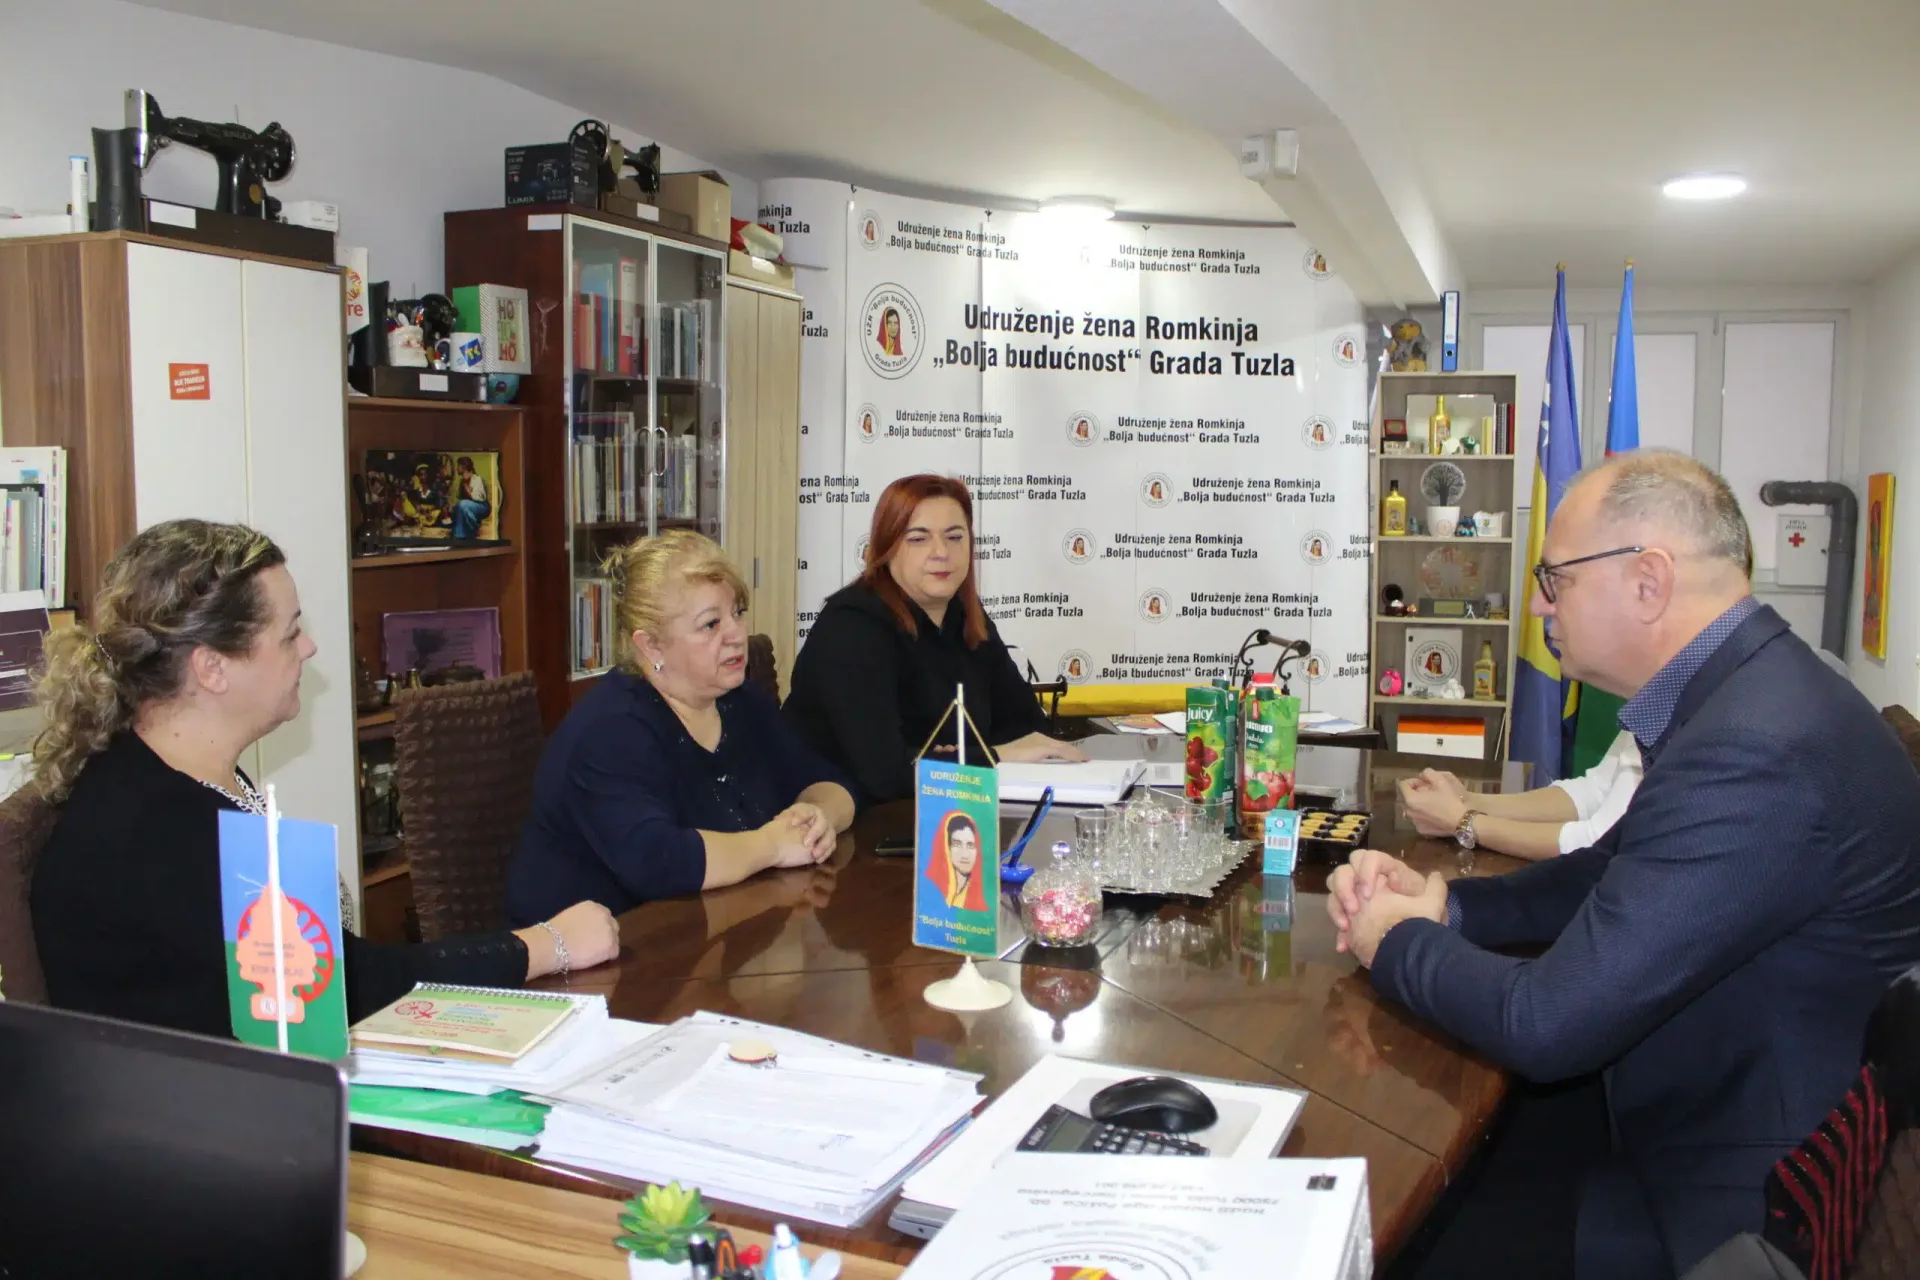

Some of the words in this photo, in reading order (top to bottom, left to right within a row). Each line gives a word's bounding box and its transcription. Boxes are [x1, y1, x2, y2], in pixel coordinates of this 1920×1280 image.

[758, 204, 792, 219] mkinja
[779, 220, 810, 234] Tuzla
[898, 220, 941, 238] Udruženje
[943, 225, 963, 240] žena
[966, 230, 1006, 246] Romkinja
[966, 245, 992, 258] Grada
[994, 247, 1019, 261] Tuzla
[1119, 244, 1168, 260] Udruženje
[1171, 246, 1196, 259] žena
[1198, 248, 1245, 261] Romkinja
[1200, 262, 1231, 274] Grada
[1234, 263, 1260, 275] Tuzla
[801, 324, 829, 338] Tuzla
[964, 303, 1075, 340] Udruženje
[1082, 311, 1136, 339] žena
[1145, 315, 1259, 347] Romkinja
[933, 339, 998, 372] „Bolja
[1005, 343, 1142, 374] budućnost“
[1150, 350, 1222, 376] Grada
[1231, 351, 1295, 377] Tuzla
[896, 409, 937, 423] Udruženje
[939, 411, 960, 423] žena
[1118, 415, 1167, 430] Udruženje
[1170, 417, 1194, 429] žena
[1197, 418, 1245, 431] Romkinja
[993, 427, 1014, 439] Tuzla
[1199, 432, 1230, 444] Grada
[1233, 433, 1260, 444] Tuzla
[800, 477, 821, 487] ena
[1003, 475, 1023, 486] žena
[1026, 474, 1072, 487] Romkinja
[1192, 477, 1244, 490] Udruženje
[1247, 478, 1271, 489] žena
[1274, 477, 1321, 490] Romkinja
[850, 490, 870, 503] Tuzla
[1028, 489, 1057, 500] Grada
[1060, 489, 1086, 501] Tuzla
[1276, 492, 1307, 503] Grada
[1310, 492, 1336, 503] Tuzla
[1114, 533, 1166, 546] Udruženje
[1168, 534, 1192, 545] žena
[1195, 533, 1243, 546] Romkinja
[992, 548, 1012, 560] Tuzla
[1197, 548, 1228, 559] Grada
[1230, 548, 1258, 559] Tuzla
[1001, 593, 1020, 604] žena
[1023, 592, 1069, 605] Romkinja
[1191, 592, 1242, 605] Udruženje
[1244, 593, 1268, 603] žena
[1272, 592, 1318, 605] Romkinja
[1025, 607, 1054, 618] Grada
[1057, 606, 1083, 617] Tuzla
[1273, 607, 1304, 618] Grada
[1307, 607, 1332, 618] Tuzla
[1111, 653, 1164, 666] Udruženje
[1166, 653, 1190, 664] žena
[1193, 652, 1240, 666] Romkinja
[1195, 667, 1225, 678] Grada
[1187, 707, 1214, 721] Juicy
[929, 770, 982, 786] UDRUŽENJE
[921, 784, 945, 797] ŽENA
[946, 789, 991, 804] ROMKINJA
[944, 932, 967, 945] Tuzla
